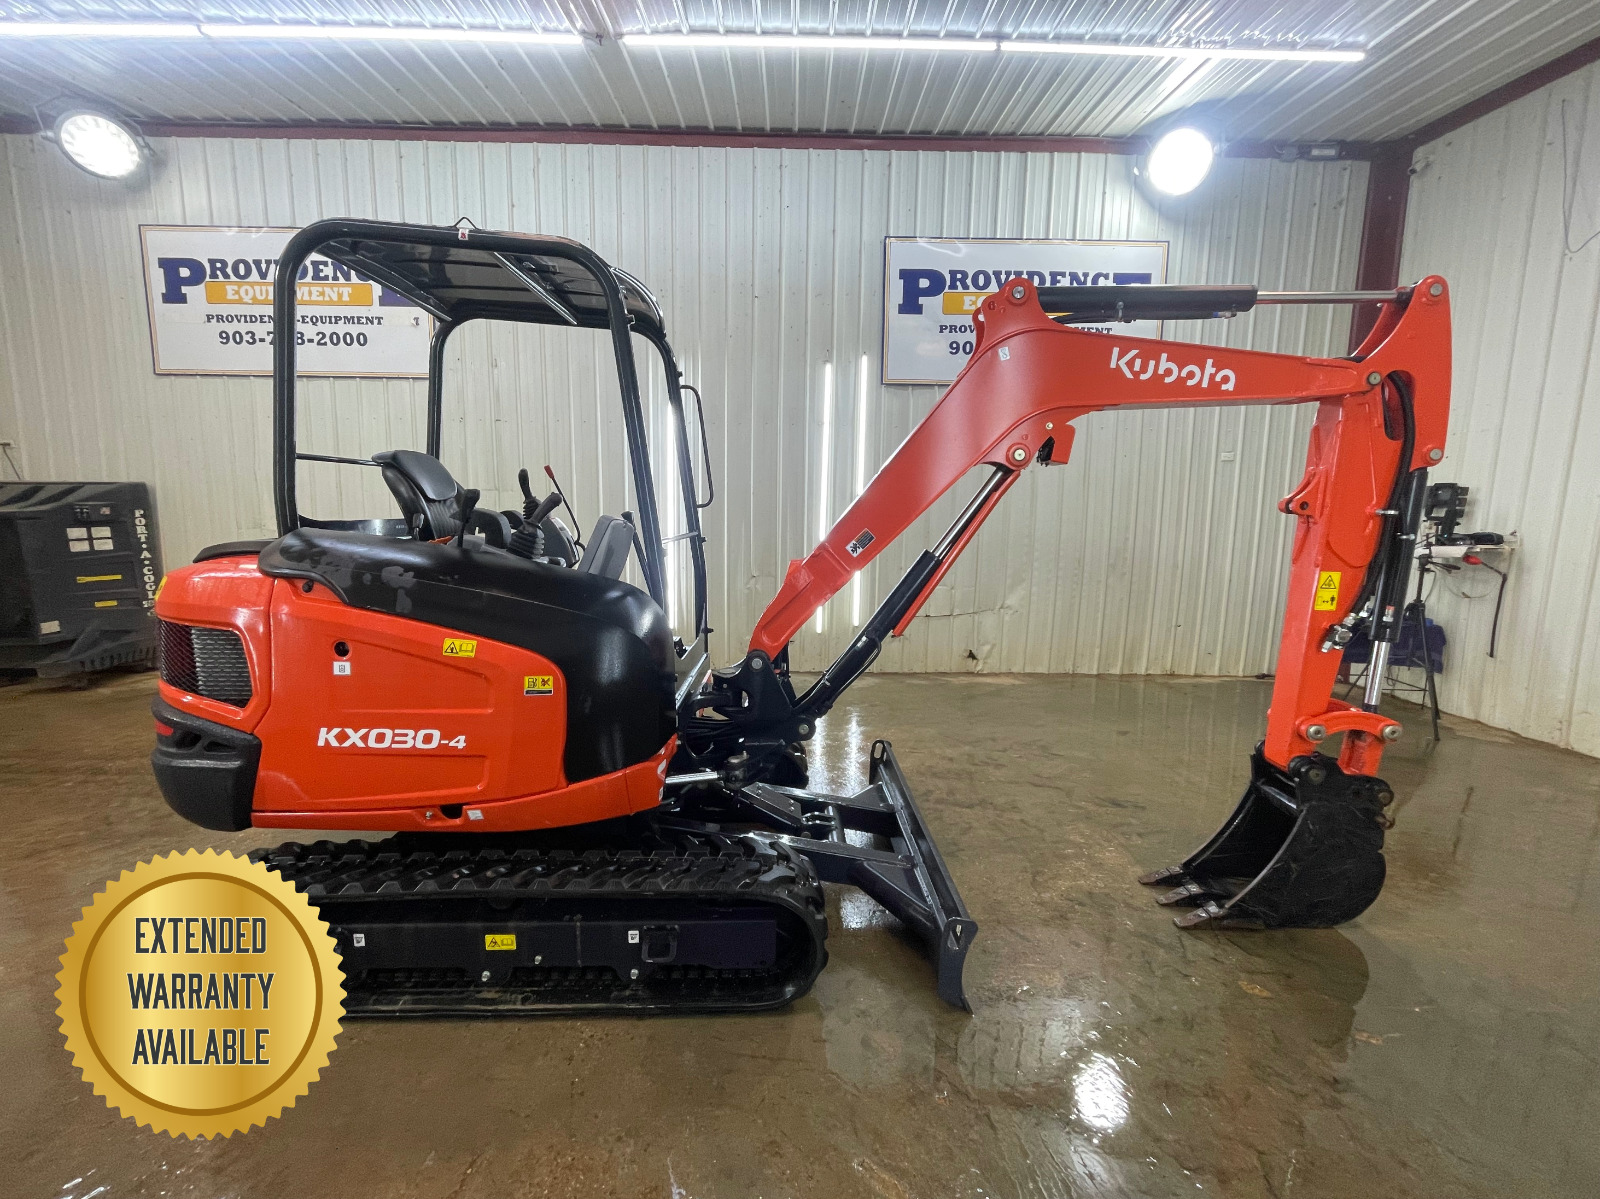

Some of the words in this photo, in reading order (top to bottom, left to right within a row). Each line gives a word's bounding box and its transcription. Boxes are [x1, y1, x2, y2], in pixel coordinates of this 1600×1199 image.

[226, 285, 352, 303] EQUIMENT
[218, 330, 368, 347] 903-78-2000
[1110, 347, 1236, 391] Kubota
[317, 727, 467, 750] KX030-4
